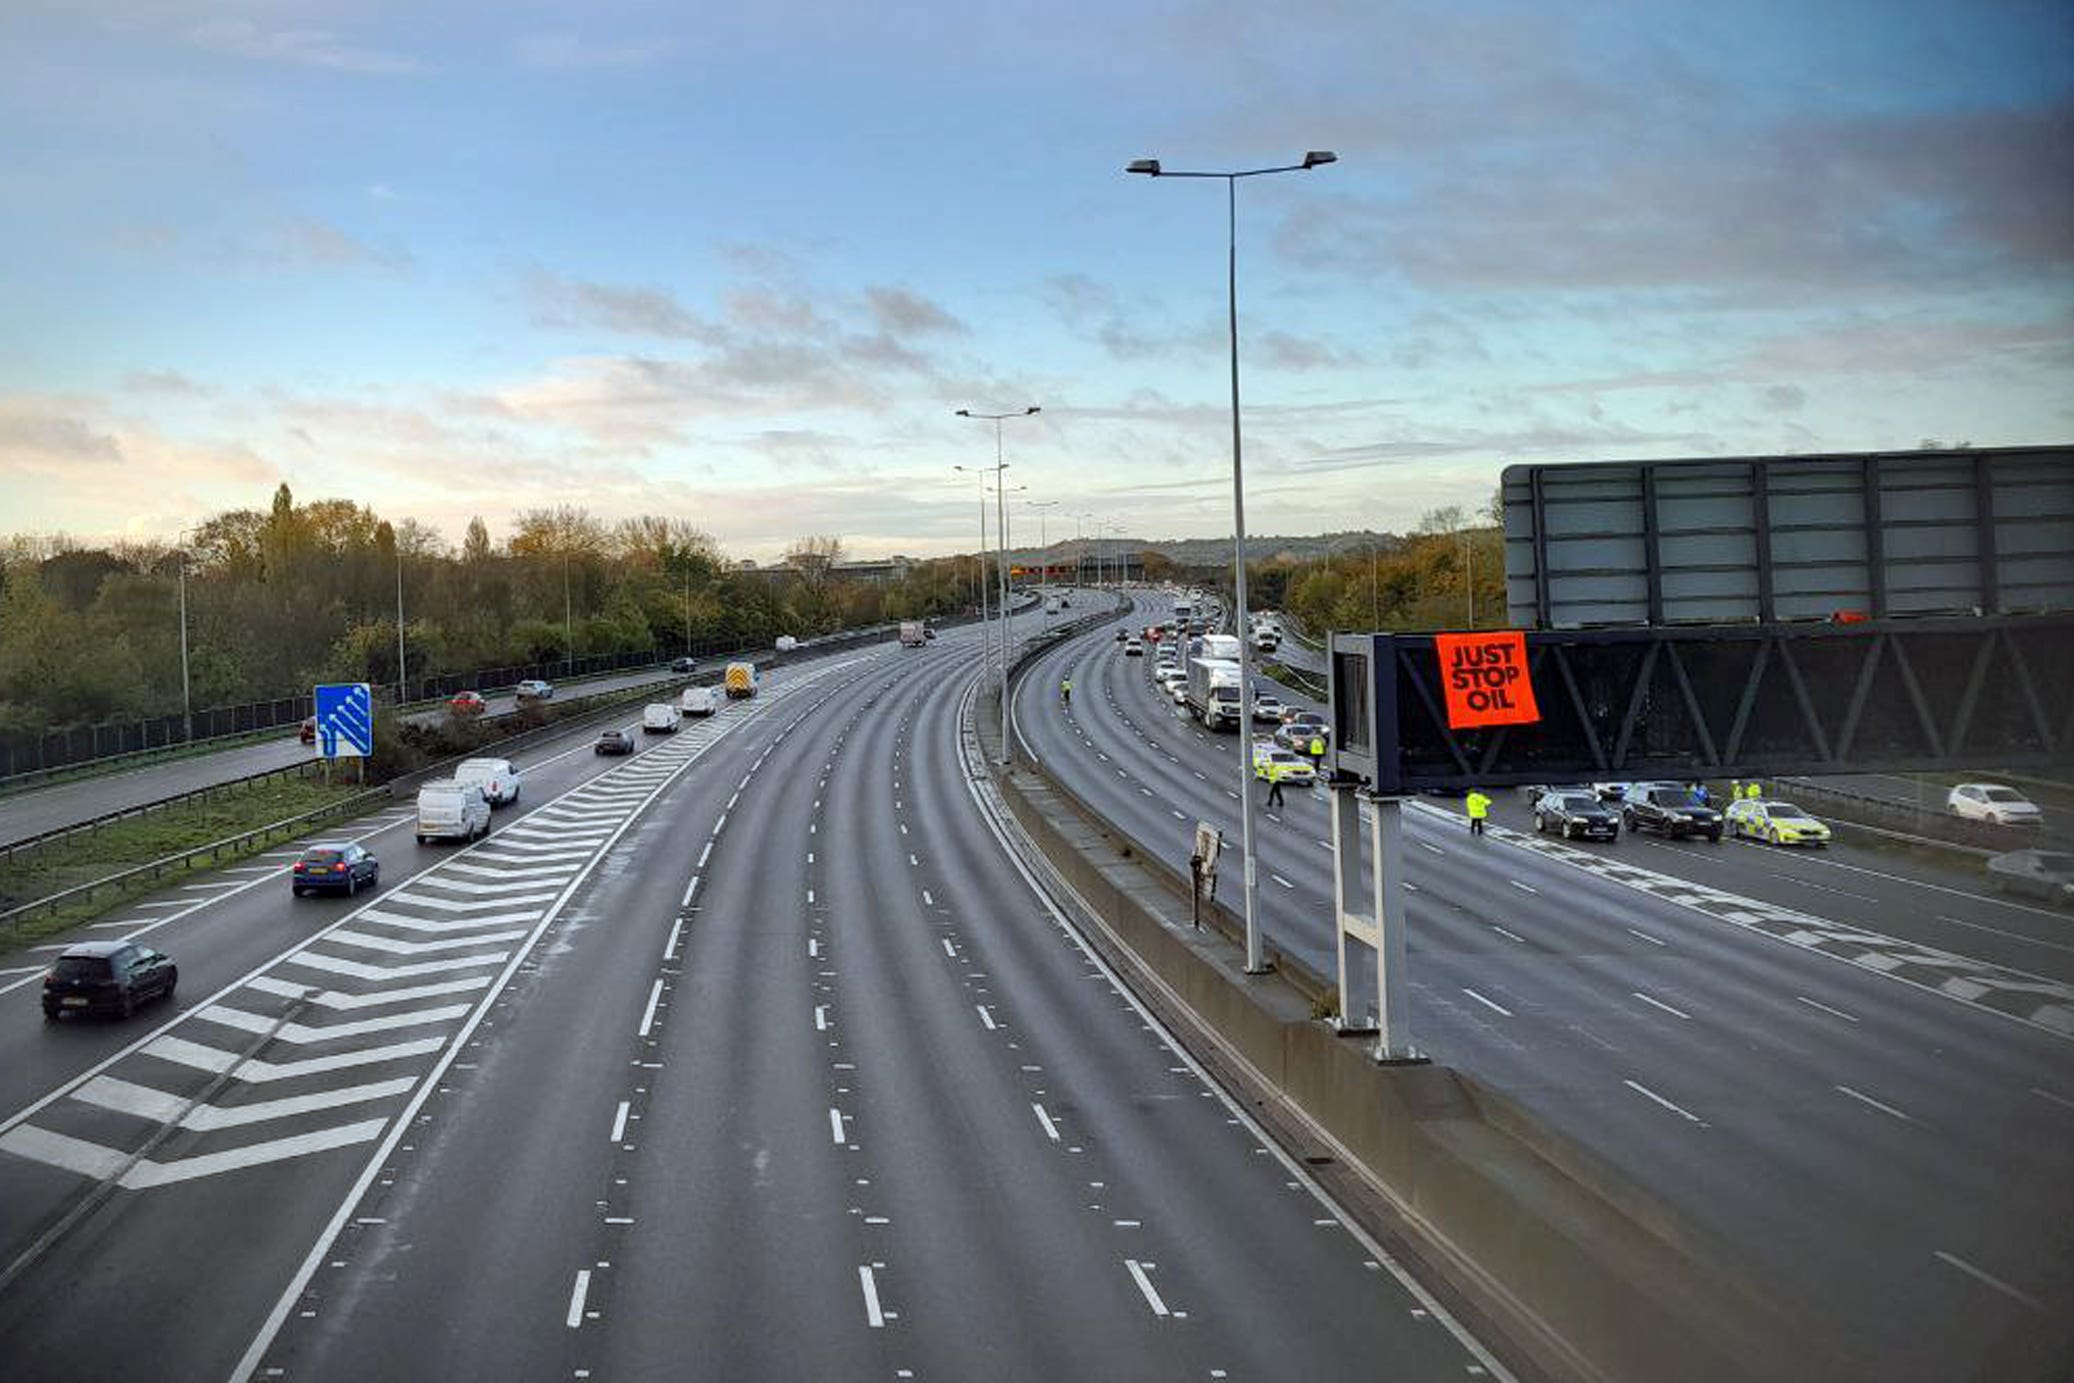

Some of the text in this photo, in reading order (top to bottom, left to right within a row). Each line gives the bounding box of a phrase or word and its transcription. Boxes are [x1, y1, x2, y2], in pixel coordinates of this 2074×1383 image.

[1451, 643, 1516, 667] JUST
[1452, 666, 1520, 690] STOP
[1467, 689, 1515, 711] OIL
